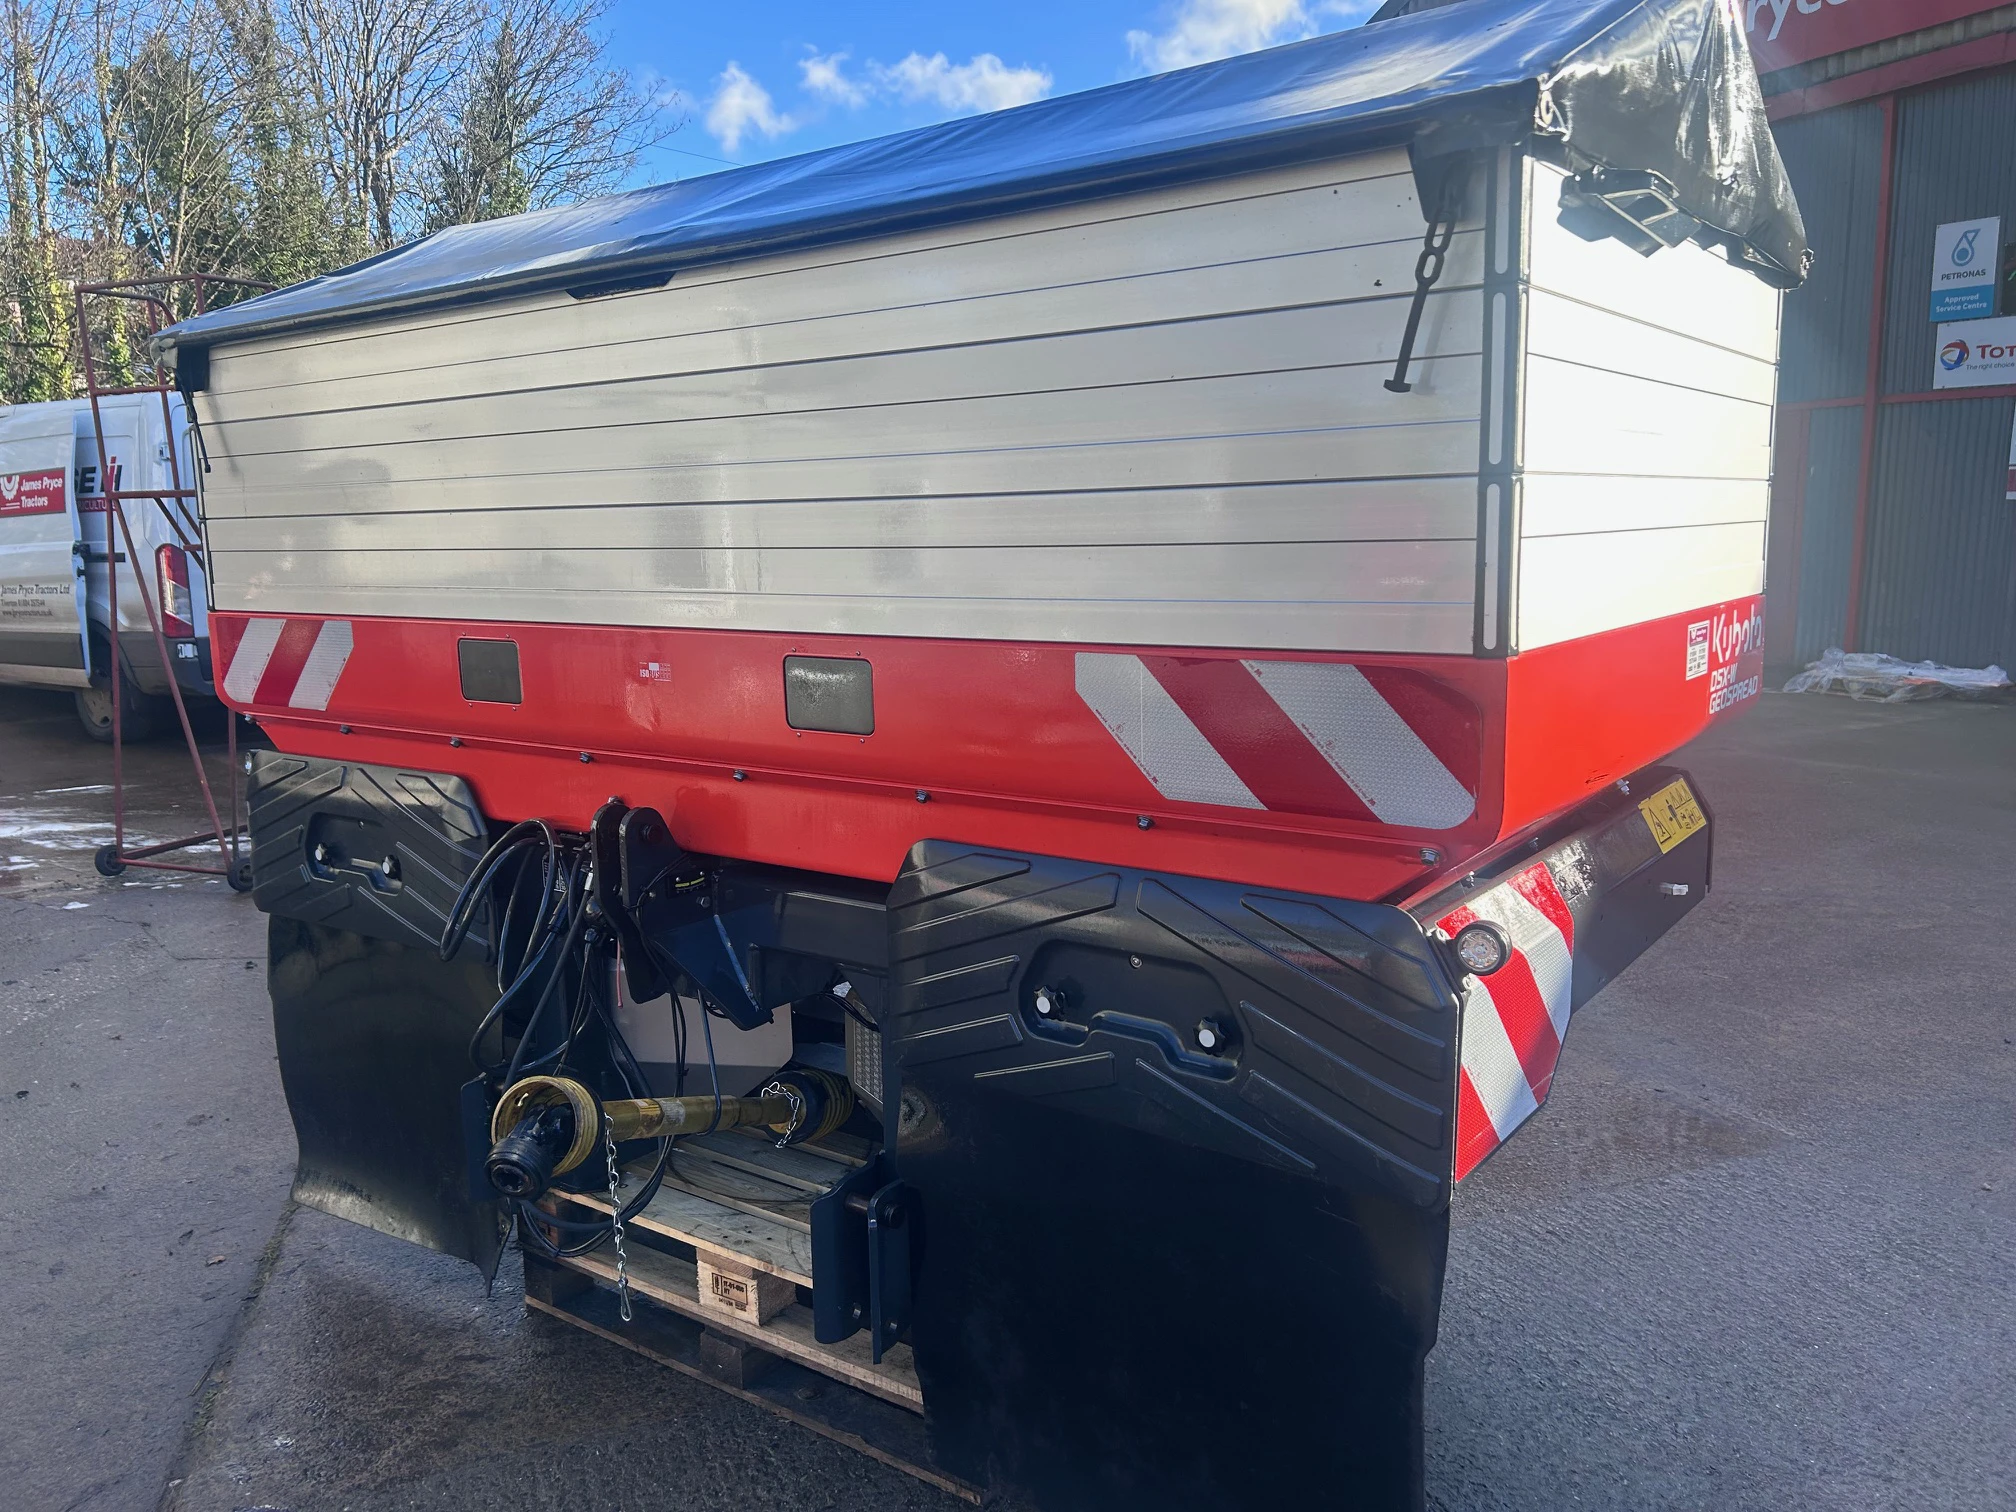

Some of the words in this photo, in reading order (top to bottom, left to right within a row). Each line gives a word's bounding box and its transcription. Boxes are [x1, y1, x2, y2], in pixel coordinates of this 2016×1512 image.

[1746, 0, 1847, 42] ry
[1941, 269, 1986, 281] PETRONAS
[1944, 293, 1980, 304] Approved
[1936, 304, 1961, 313] Service
[1962, 302, 1987, 310] Centre
[1978, 363, 1993, 371] right
[20, 478, 42, 491] James
[42, 476, 63, 491] Pryce
[21, 495, 48, 508] Tractors
[1, 584, 17, 597] James
[18, 584, 34, 598] Pryce
[34, 583, 58, 595] Tractors
[59, 583, 70, 594] Ltd
[1712, 603, 1762, 664] Kubota
[1710, 662, 1739, 693] DSX-W
[1709, 675, 1759, 715] GEOSPREAD
